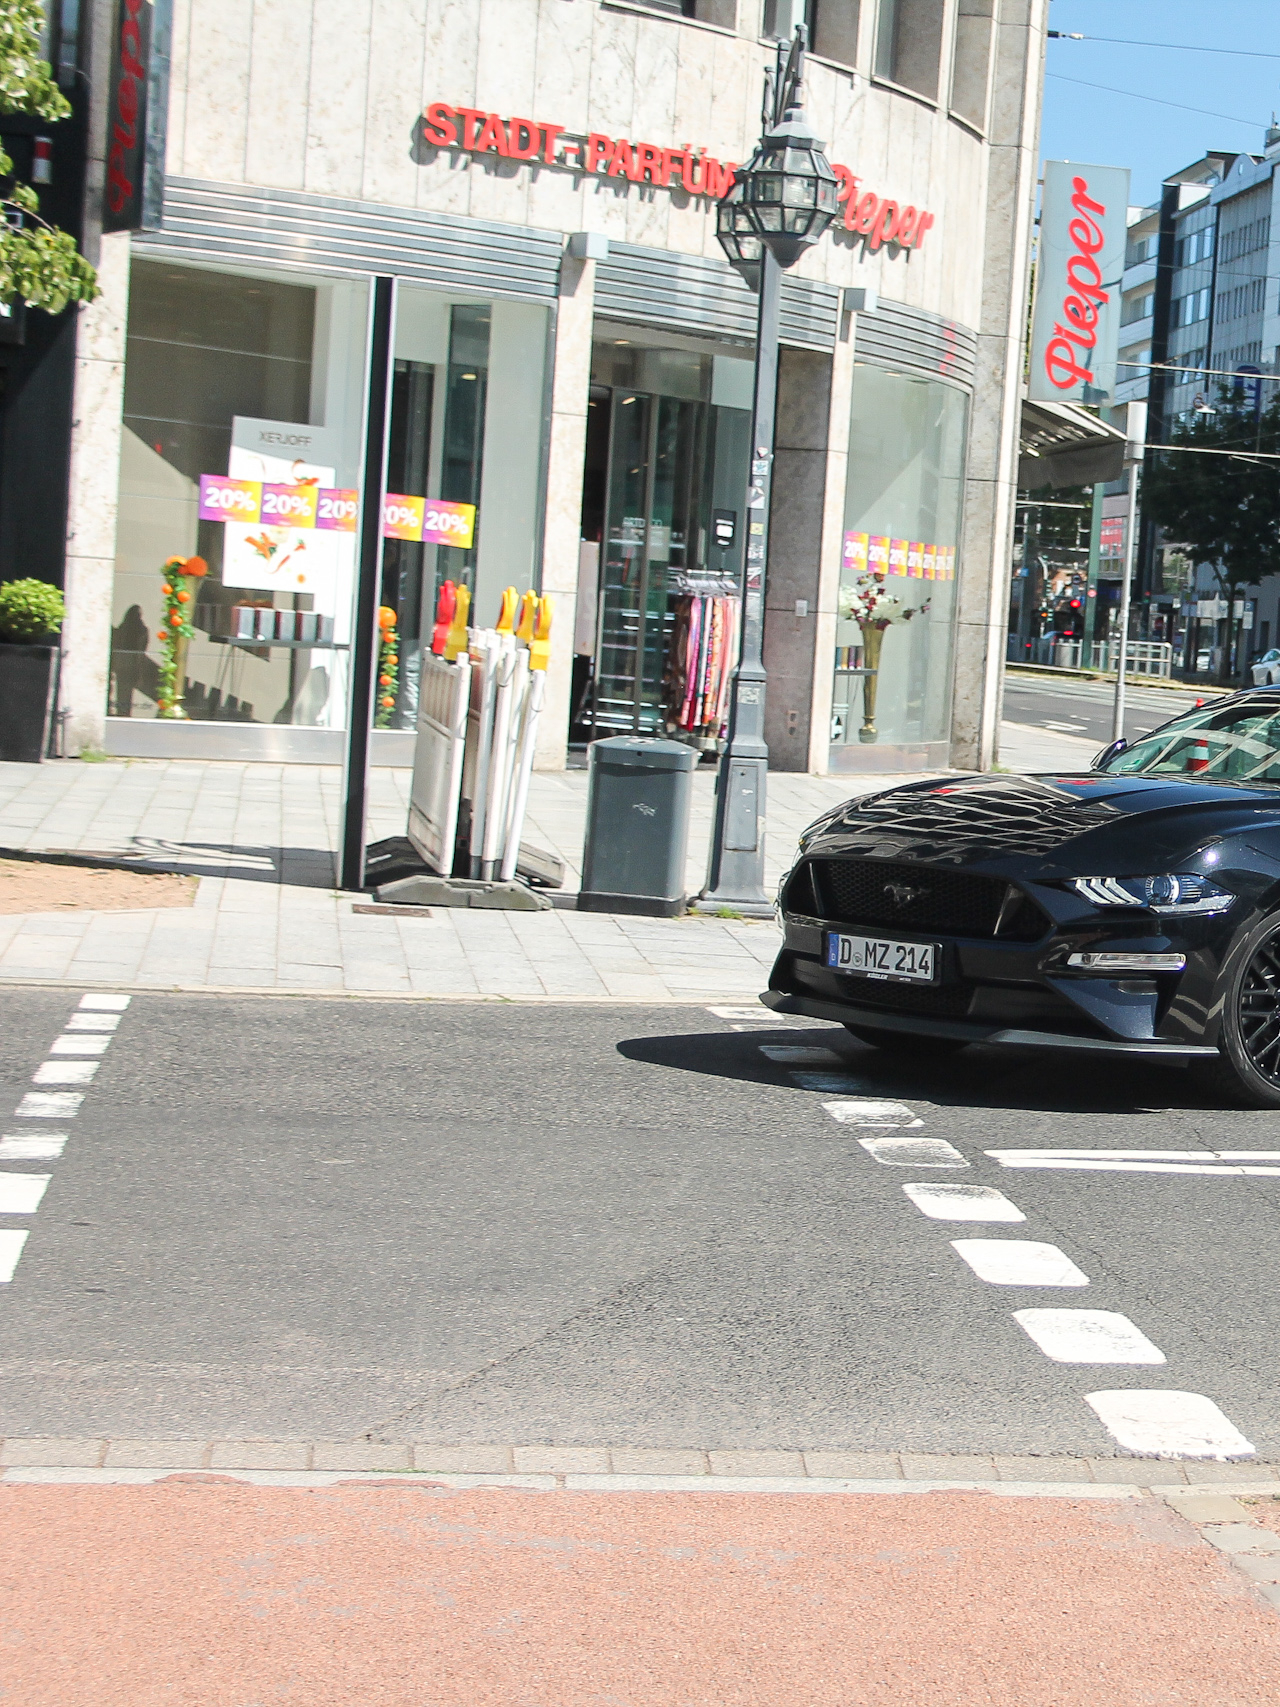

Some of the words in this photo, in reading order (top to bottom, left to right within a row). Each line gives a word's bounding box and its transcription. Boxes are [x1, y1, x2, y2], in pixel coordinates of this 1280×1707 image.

[424, 103, 739, 199] STADT-PARFÜM
[1045, 176, 1109, 389] Pieper
[204, 486, 257, 512] 20%
[262, 492, 312, 517] 20%
[385, 505, 420, 528] 0%
[425, 510, 470, 535] 20%
[840, 938, 852, 964] D
[864, 941, 890, 970] MZ
[895, 945, 930, 974] 214
